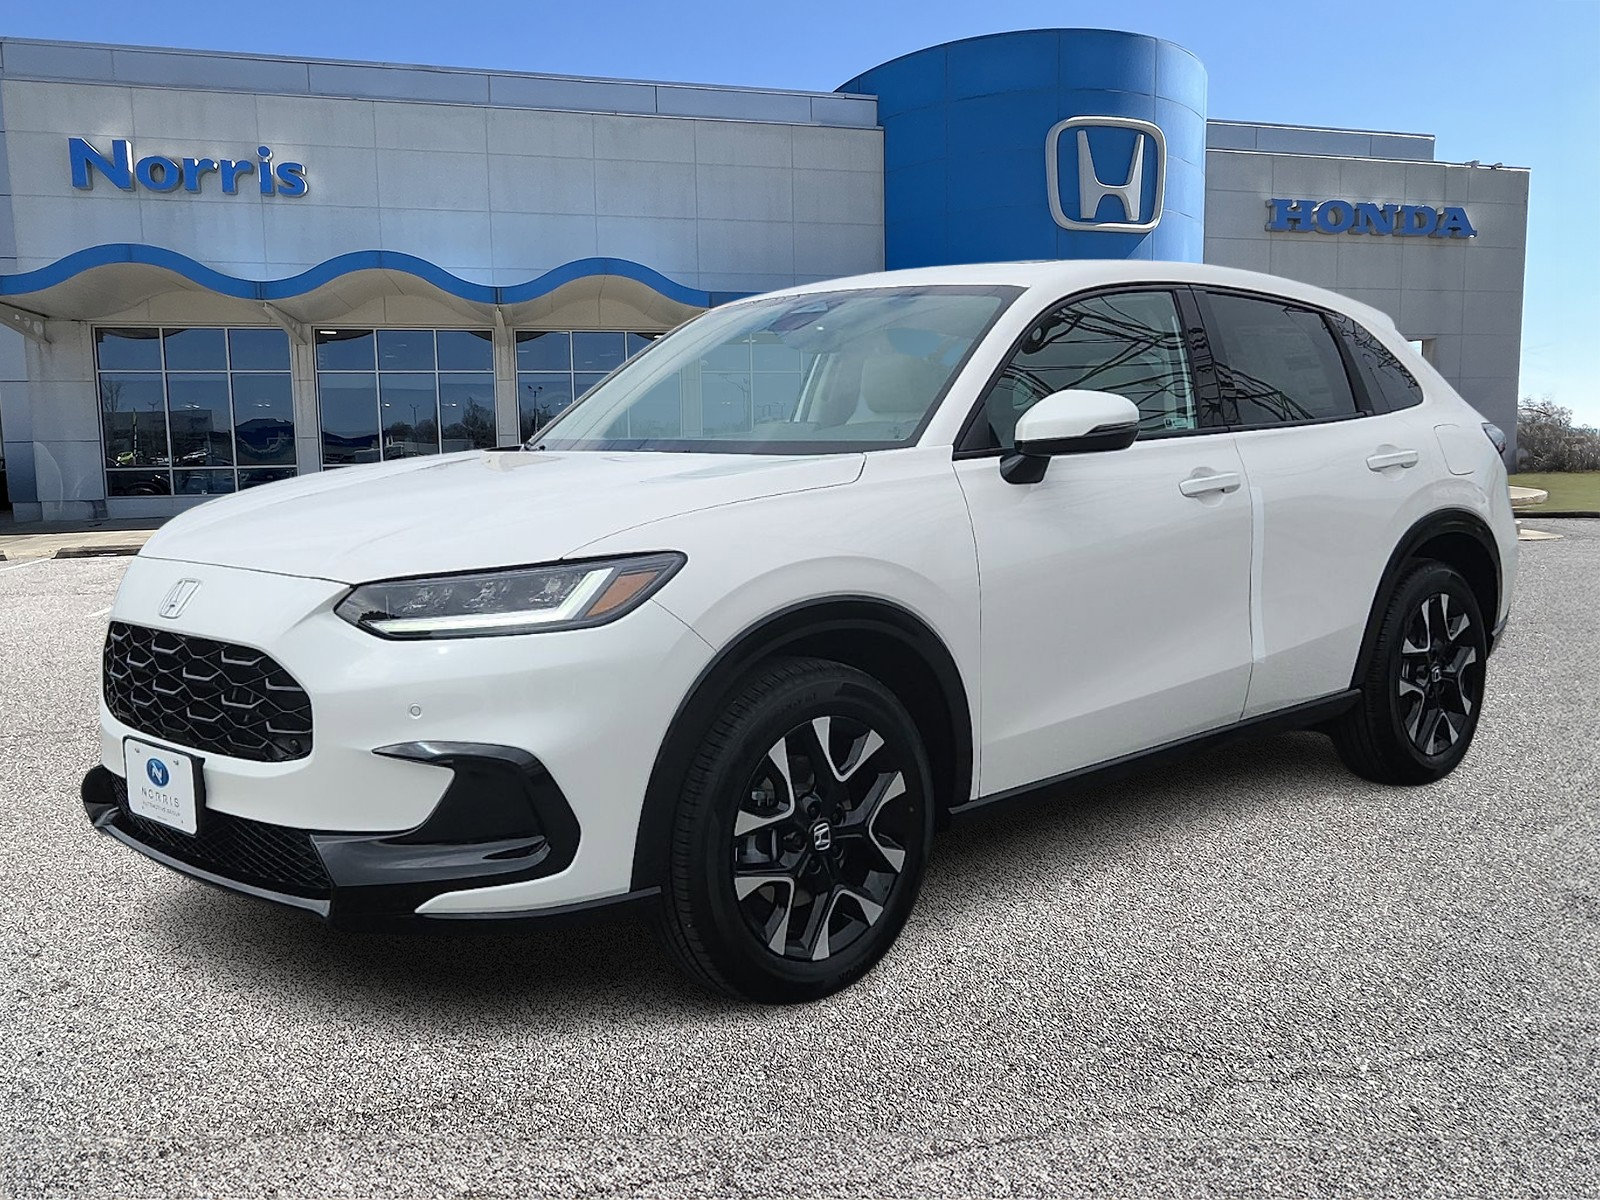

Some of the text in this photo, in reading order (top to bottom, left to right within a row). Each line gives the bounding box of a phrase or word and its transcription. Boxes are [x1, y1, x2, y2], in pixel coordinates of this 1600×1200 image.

[68, 137, 308, 197] Norris
[1265, 198, 1478, 239] HONDA
[141, 786, 180, 808] NORRIS
